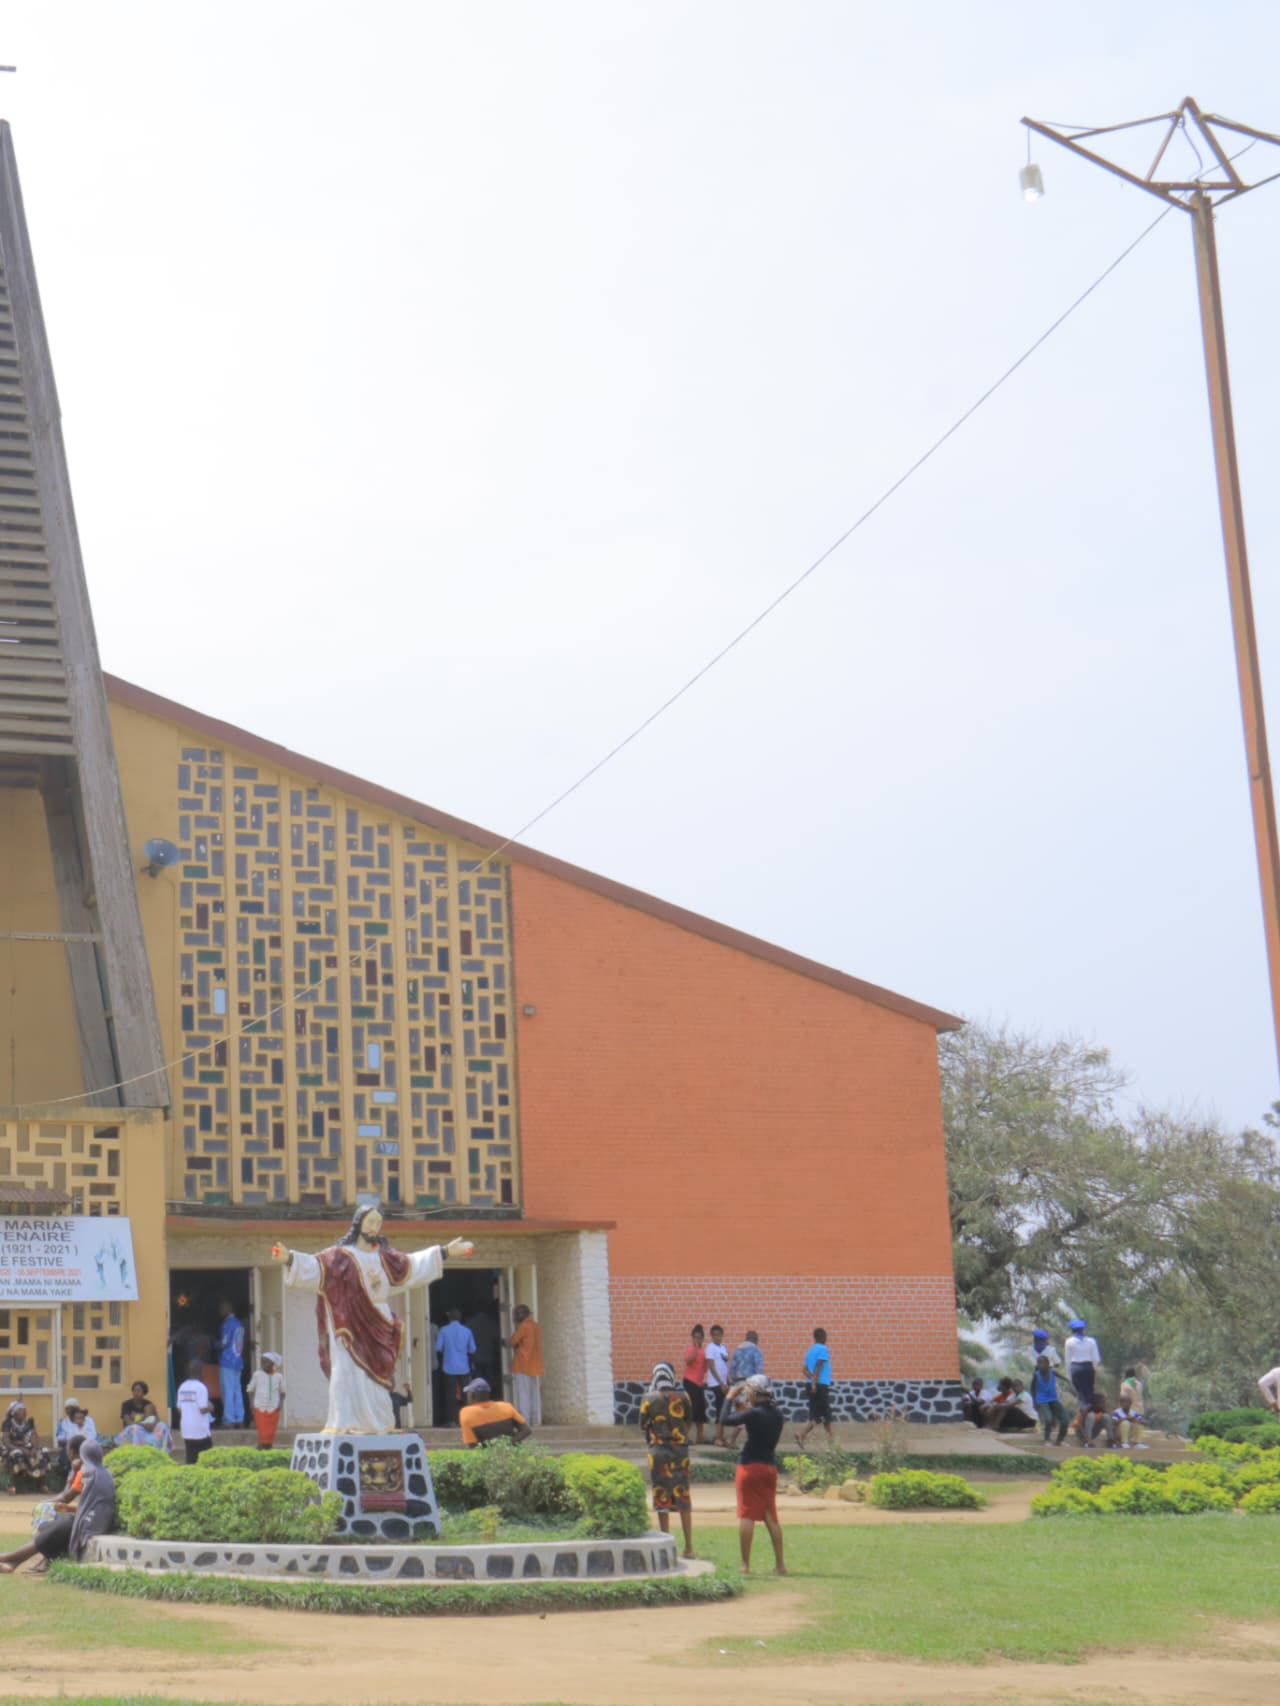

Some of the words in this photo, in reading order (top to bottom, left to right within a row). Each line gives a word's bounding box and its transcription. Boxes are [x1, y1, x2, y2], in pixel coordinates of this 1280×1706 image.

[4, 1220, 75, 1232] MARIAE
[1, 1243, 32, 1256] (1921
[43, 1244, 70, 1255] 2021
[12, 1256, 64, 1267] FESTIVE
[54, 1279, 81, 1287] MAMA
[6, 1288, 20, 1296] NA
[21, 1288, 49, 1296] MAMA
[49, 1288, 72, 1297] YAKE
